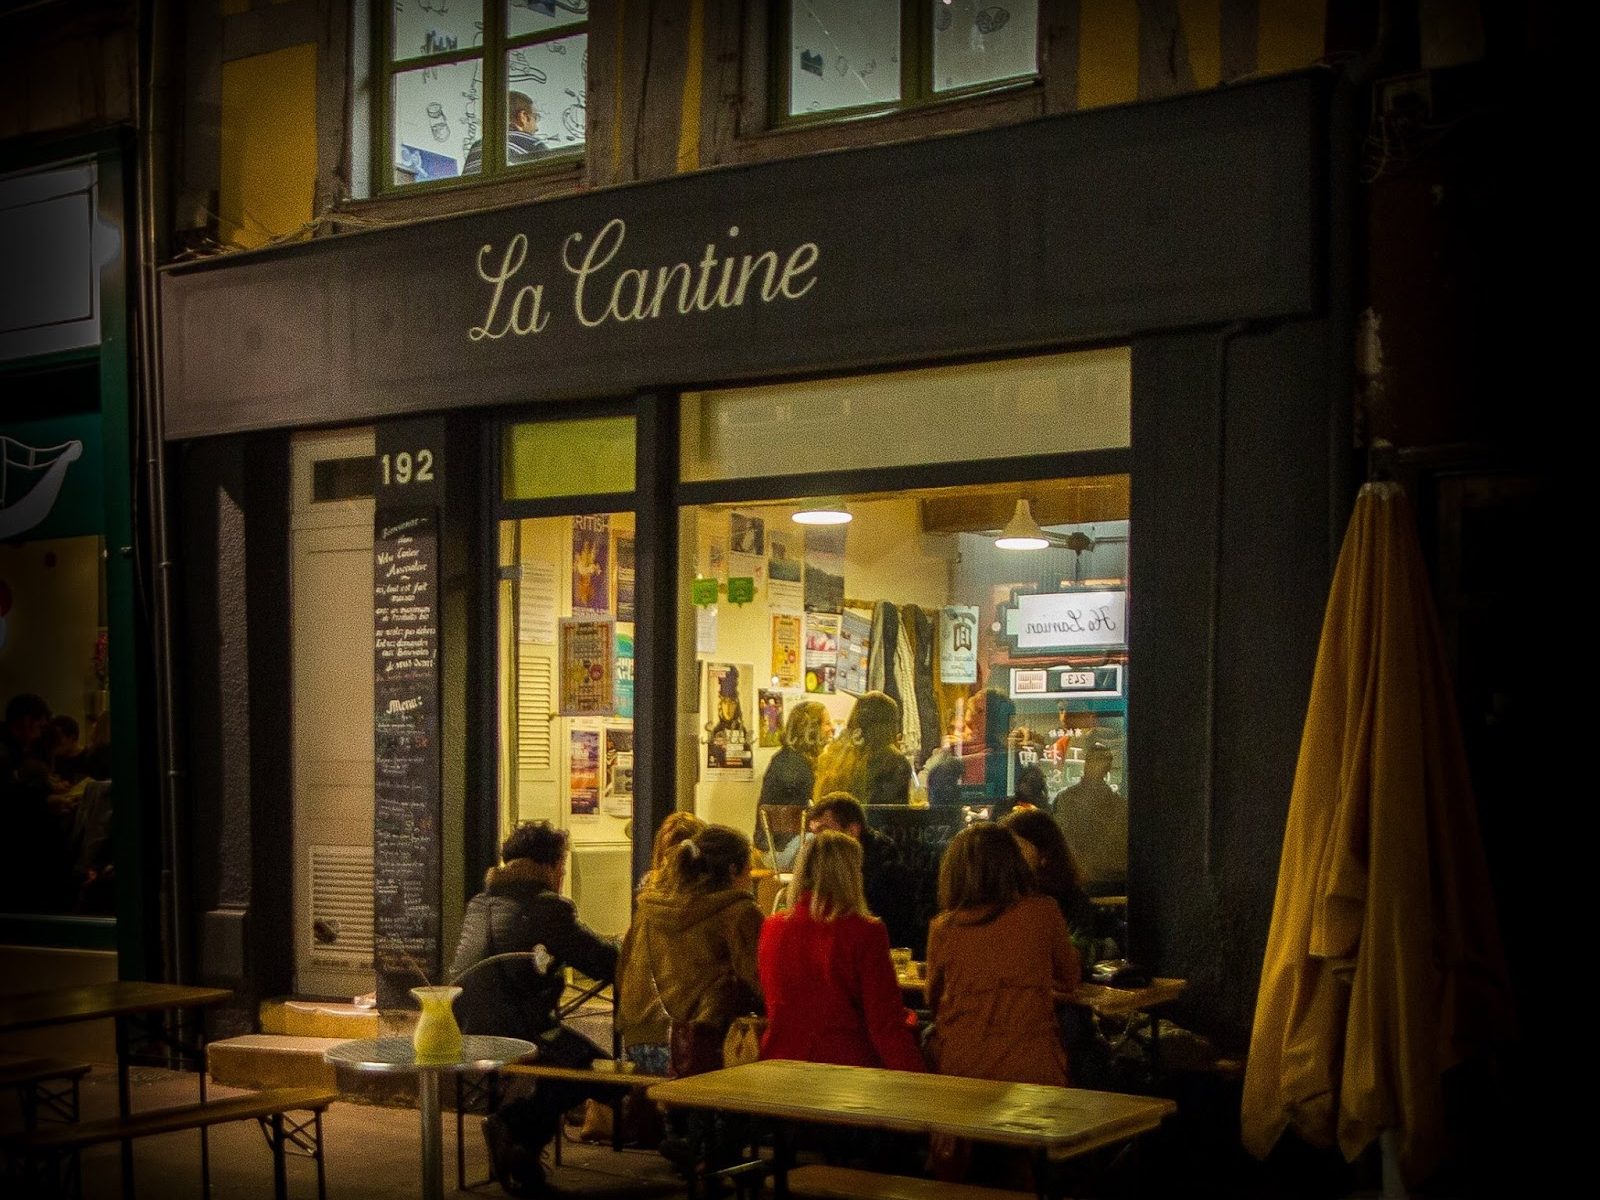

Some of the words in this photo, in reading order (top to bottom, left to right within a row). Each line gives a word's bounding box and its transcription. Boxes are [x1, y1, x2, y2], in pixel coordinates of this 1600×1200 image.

[469, 233, 551, 341] La
[561, 218, 820, 328] Cantine
[382, 449, 434, 485] 192
